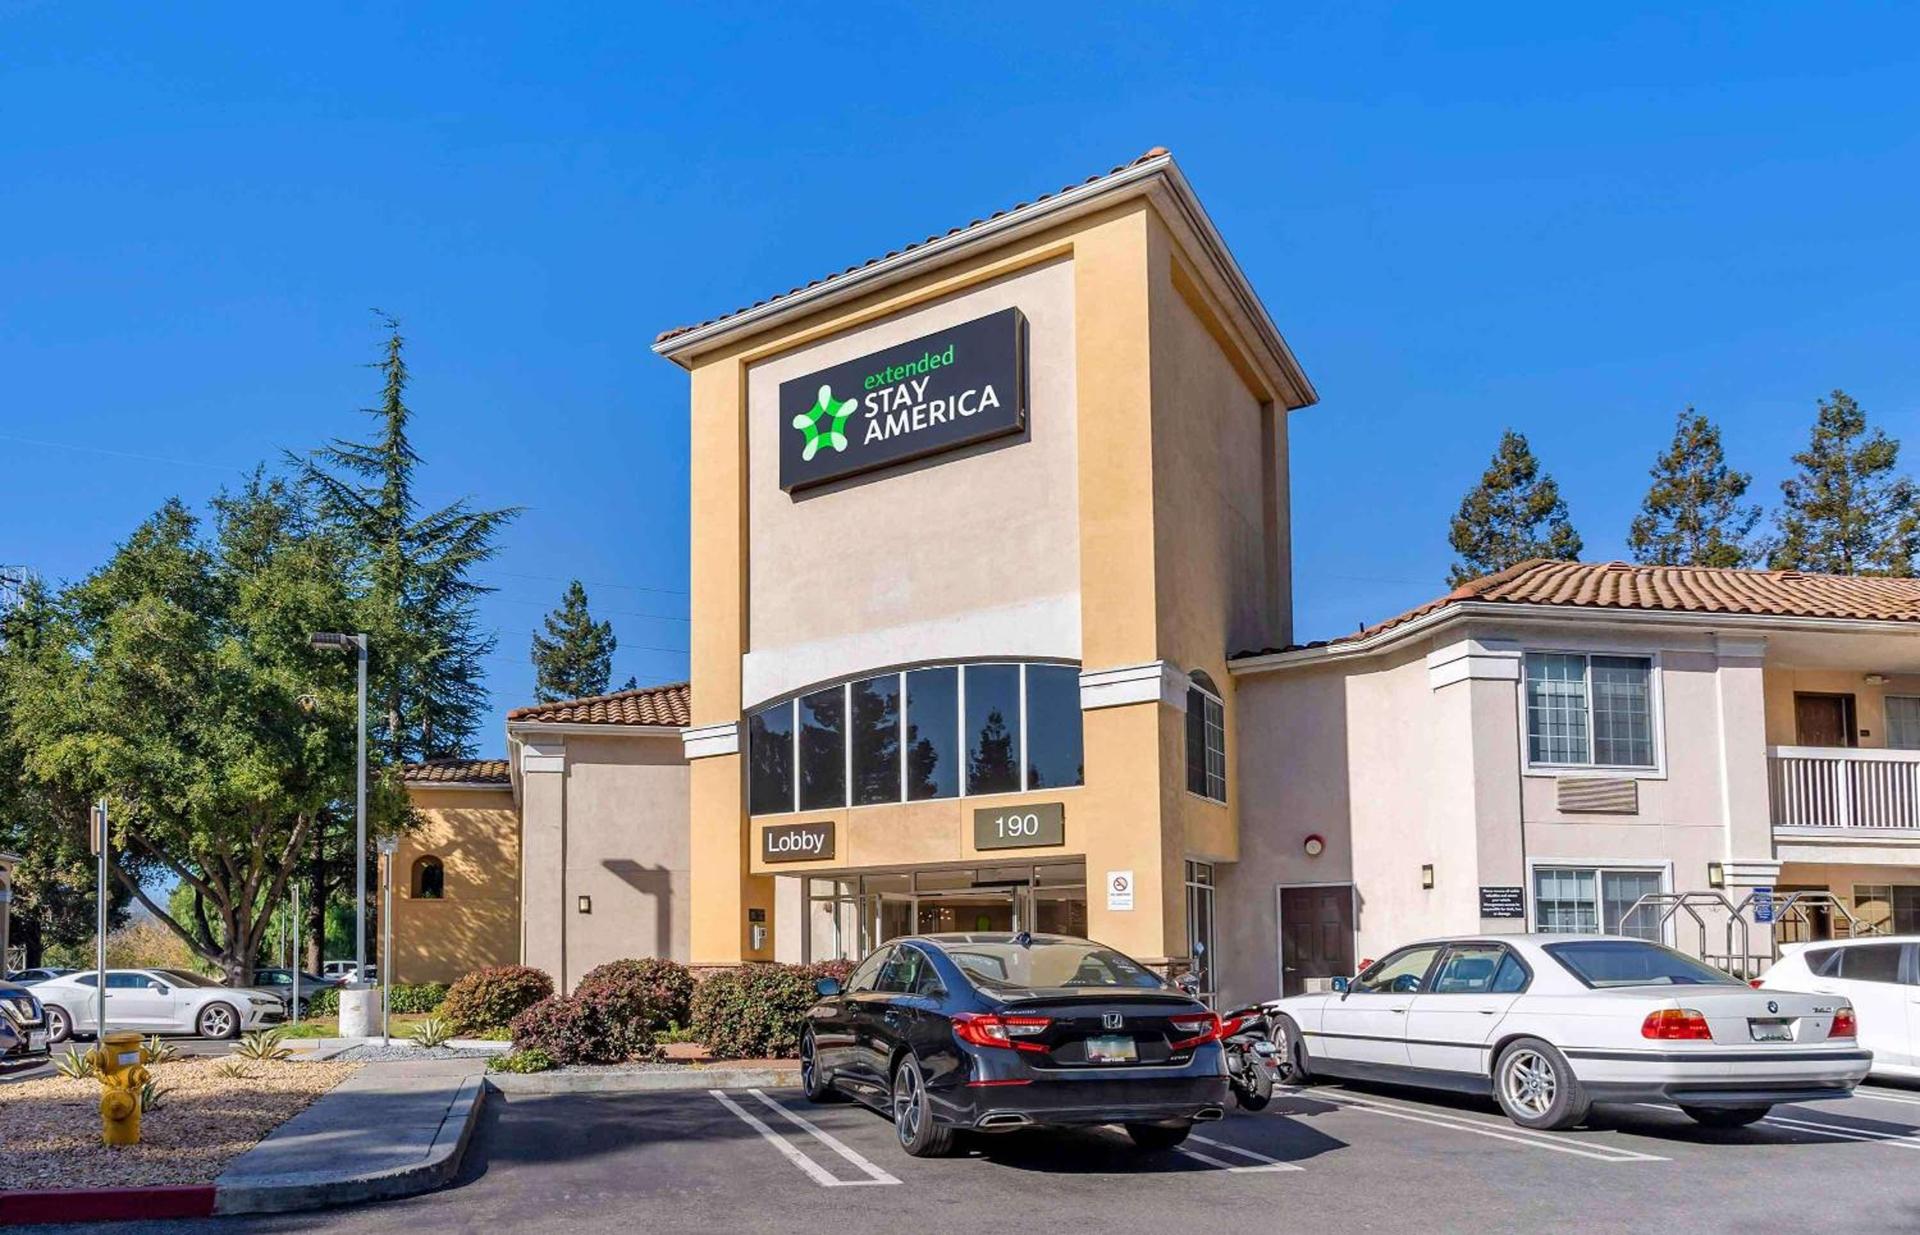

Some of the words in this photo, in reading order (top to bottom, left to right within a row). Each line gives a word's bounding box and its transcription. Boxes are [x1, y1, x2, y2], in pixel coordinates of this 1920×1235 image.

[864, 344, 955, 390] extended
[863, 385, 1001, 446] AMERICA
[864, 376, 930, 418] STAY
[768, 831, 825, 853] Lobby
[995, 813, 1039, 838] 190
